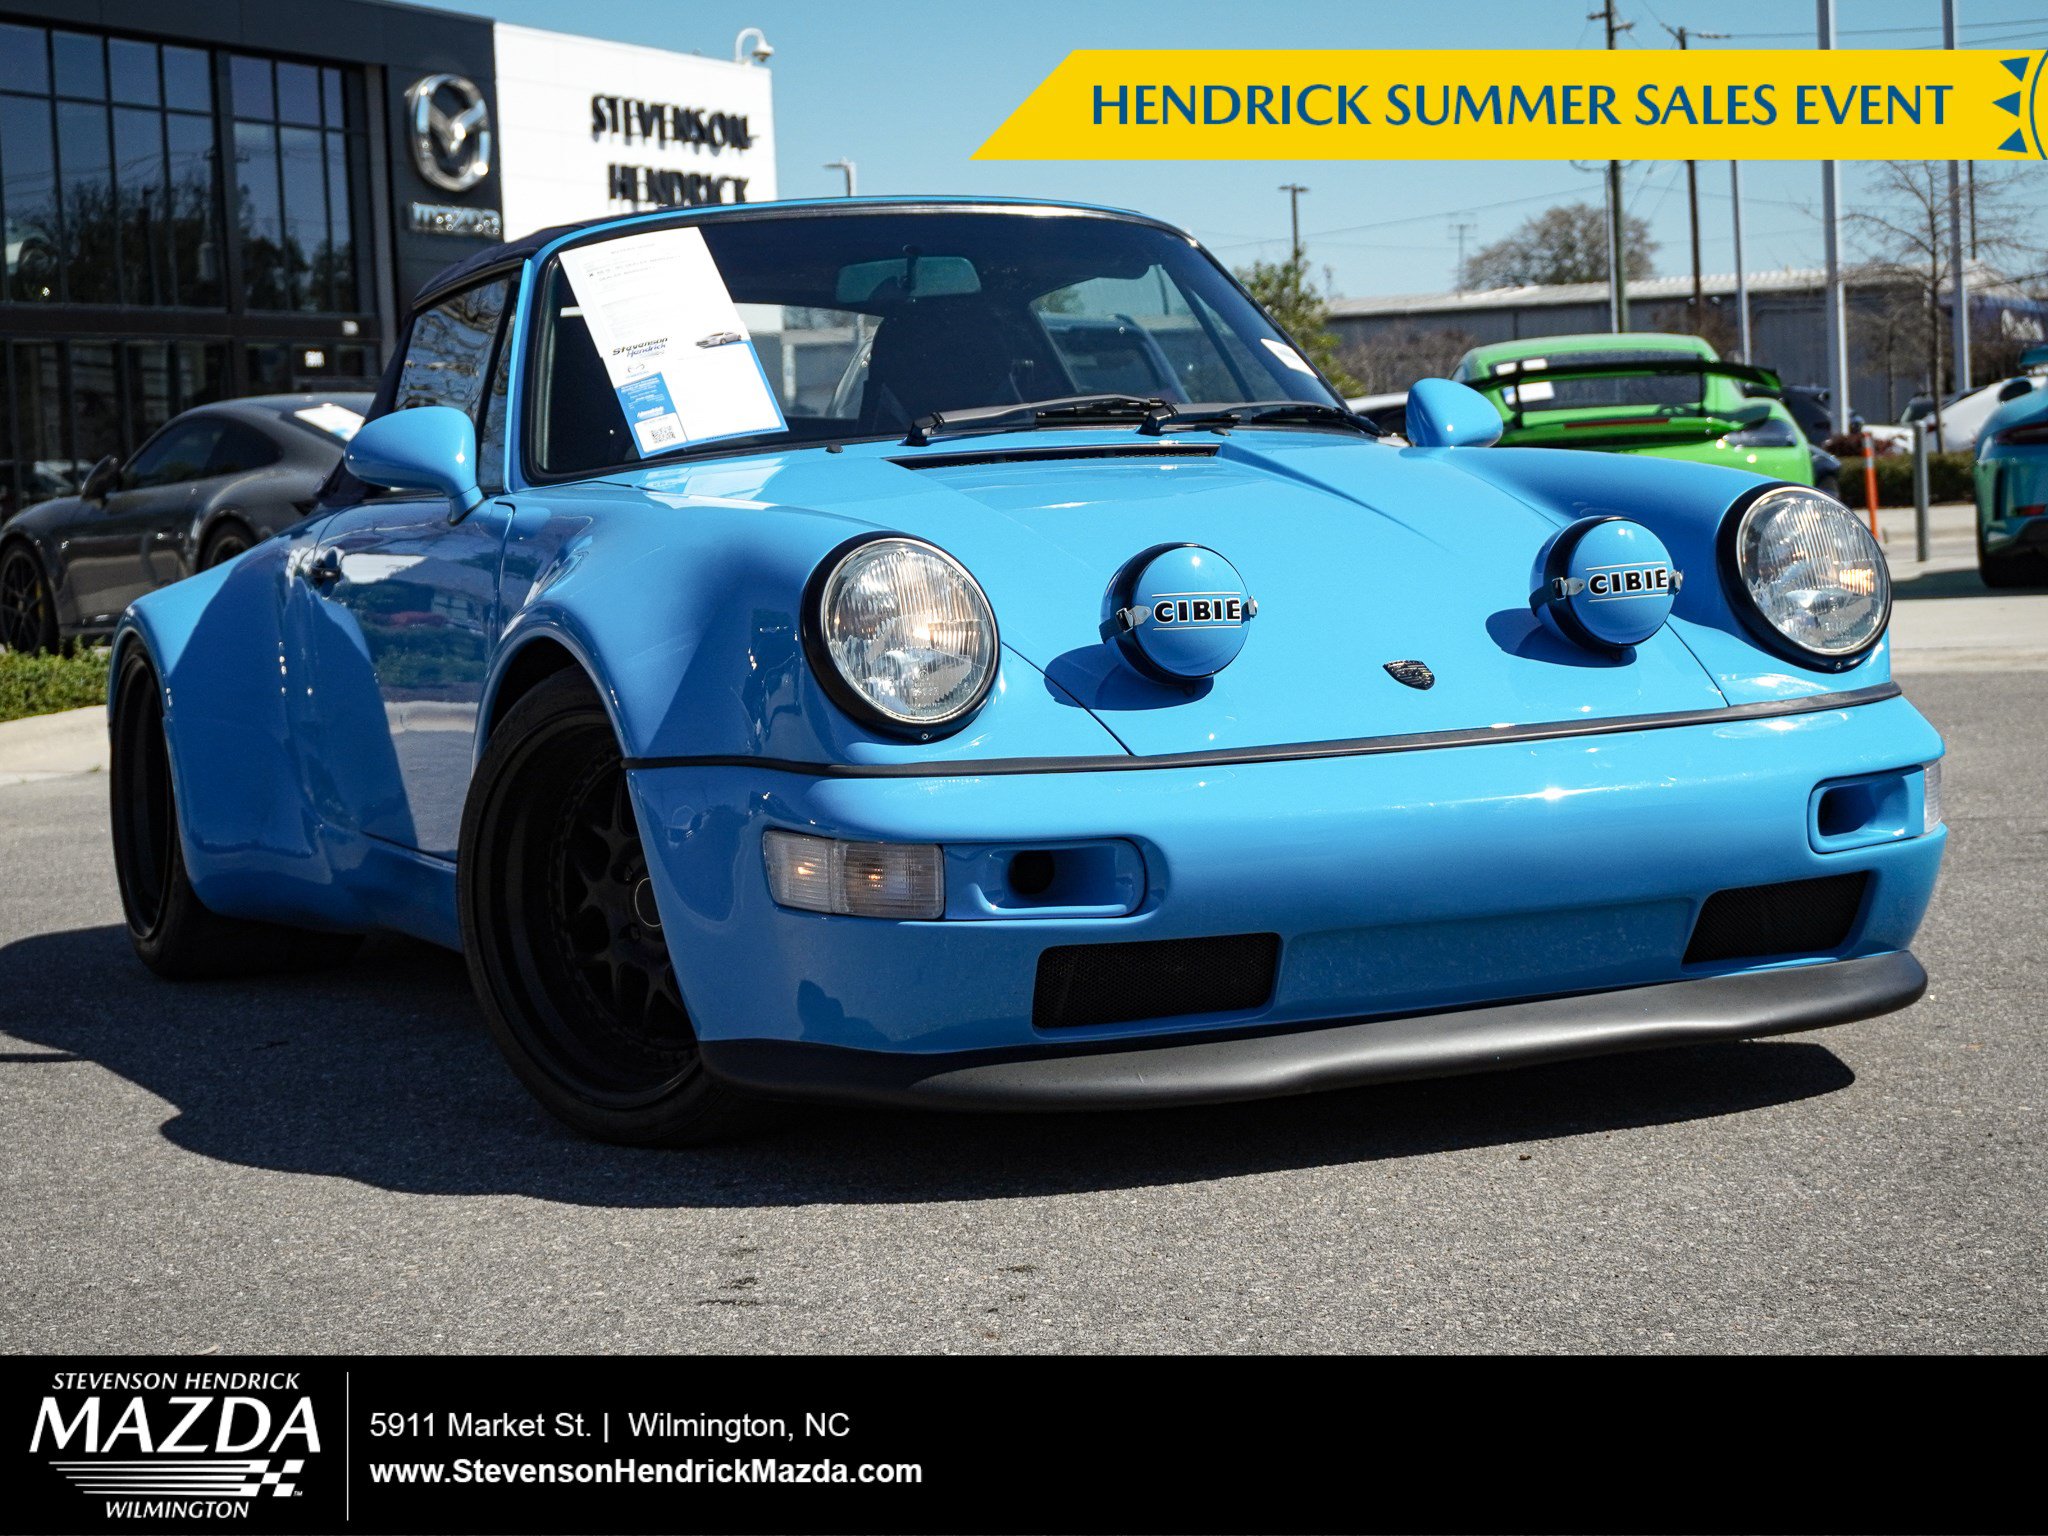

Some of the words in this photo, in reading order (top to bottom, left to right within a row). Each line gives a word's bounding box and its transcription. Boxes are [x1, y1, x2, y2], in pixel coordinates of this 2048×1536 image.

[608, 163, 750, 206] HENDRICK
[1588, 567, 1668, 596] CIBIE
[1153, 598, 1241, 623] CIBIE
